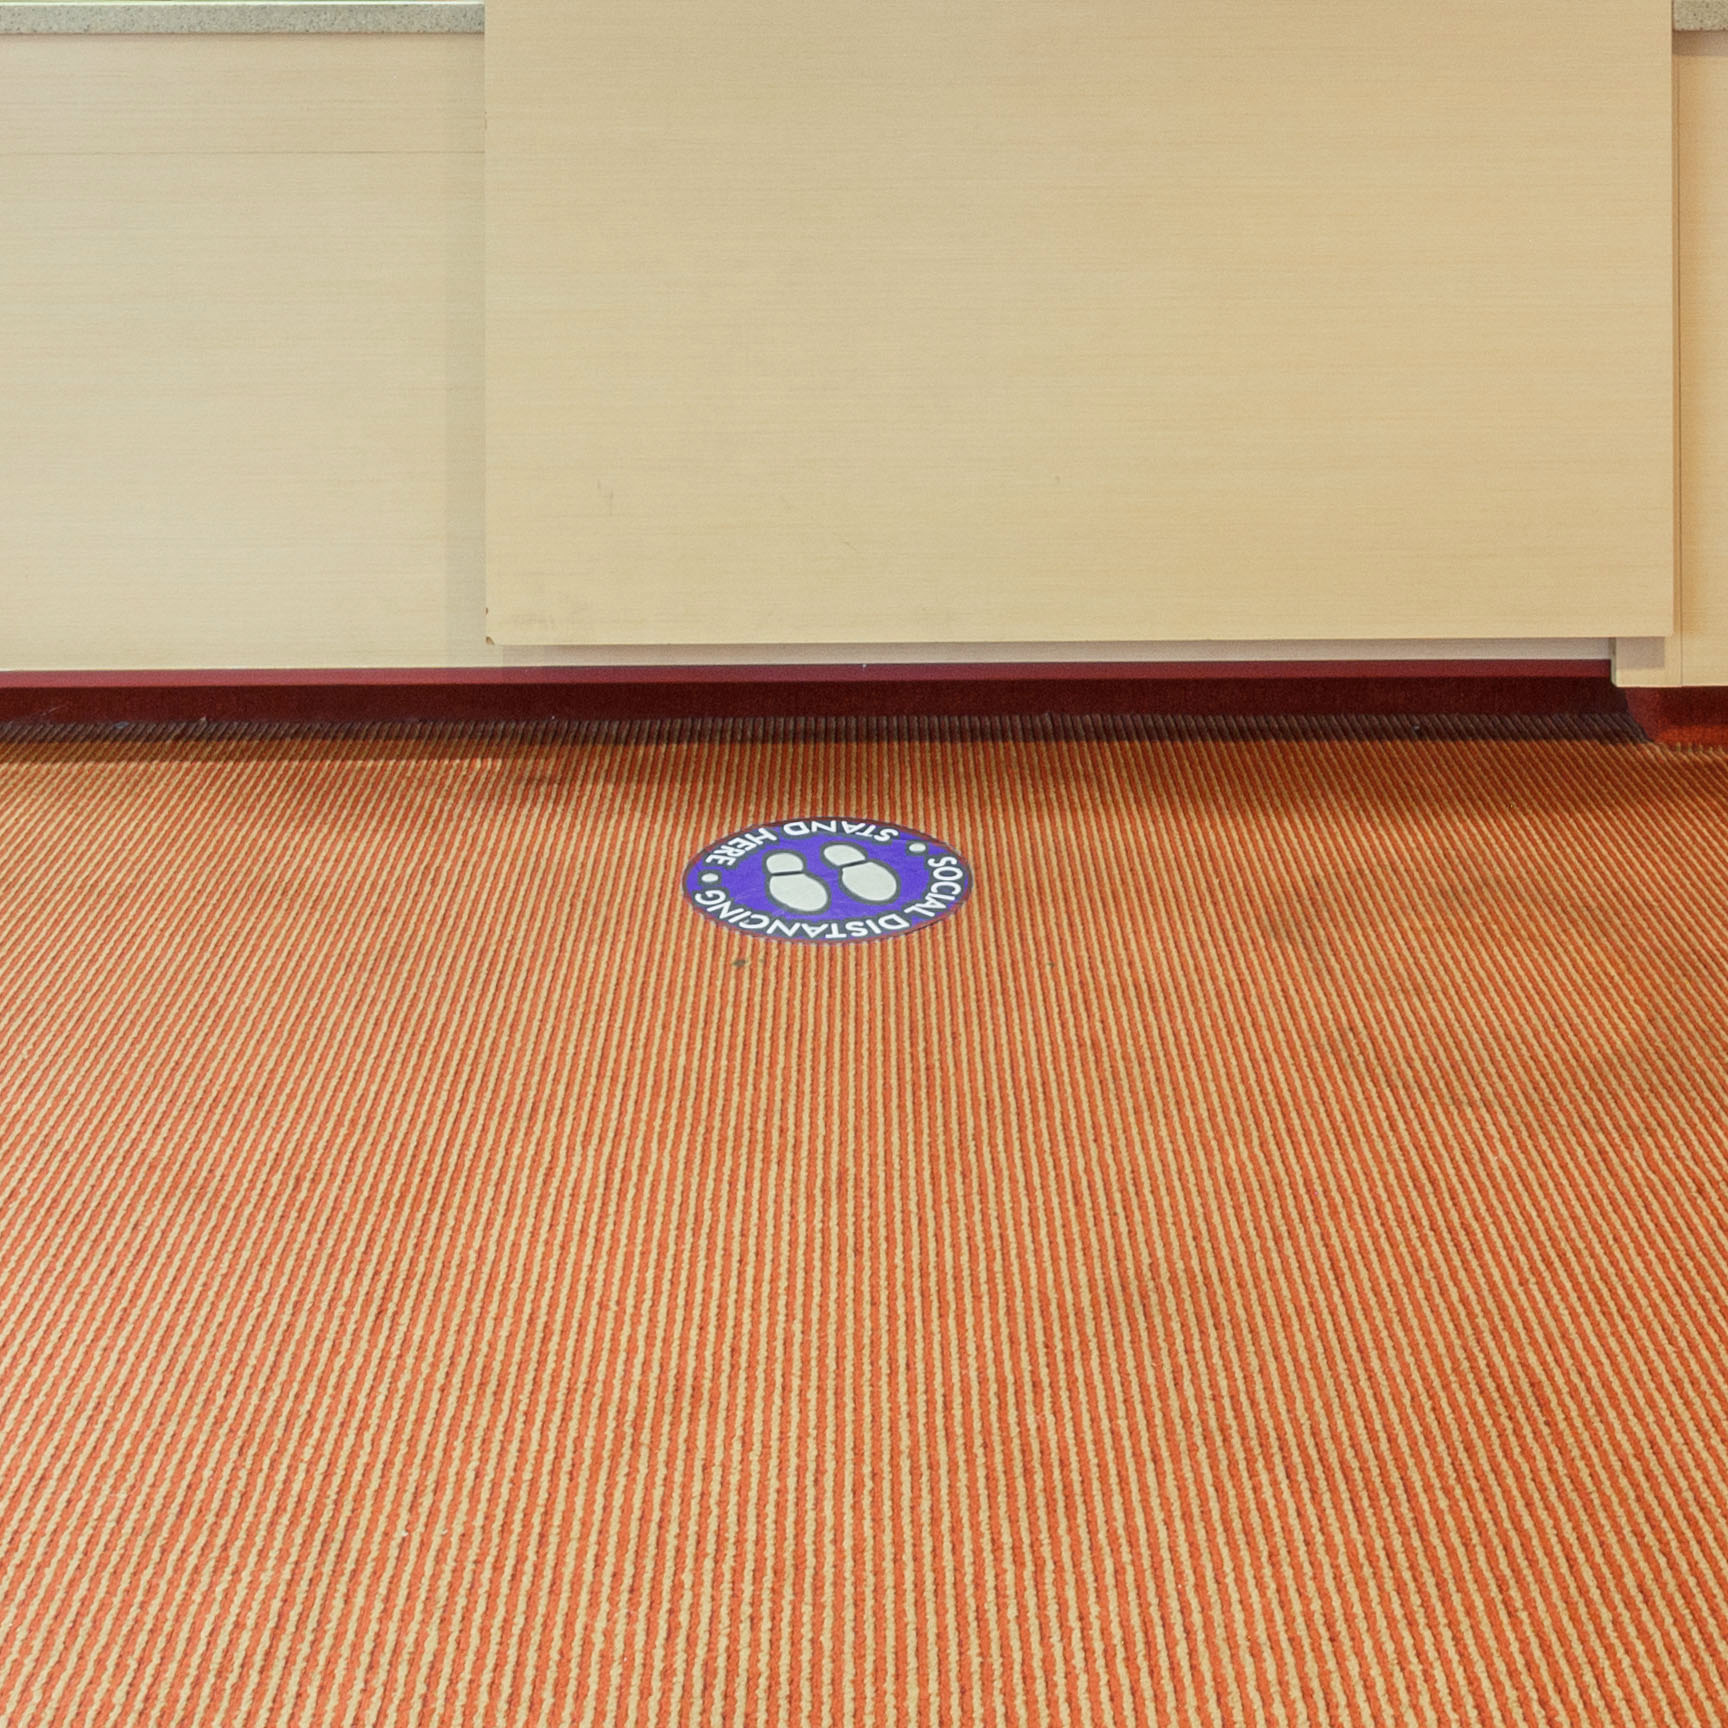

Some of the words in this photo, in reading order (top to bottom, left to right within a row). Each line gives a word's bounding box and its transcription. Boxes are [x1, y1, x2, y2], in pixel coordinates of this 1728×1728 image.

[705, 828, 777, 867] HERE
[783, 820, 899, 842] STAND
[903, 856, 964, 918] SOCIAL
[694, 889, 911, 939] DISTANCING
